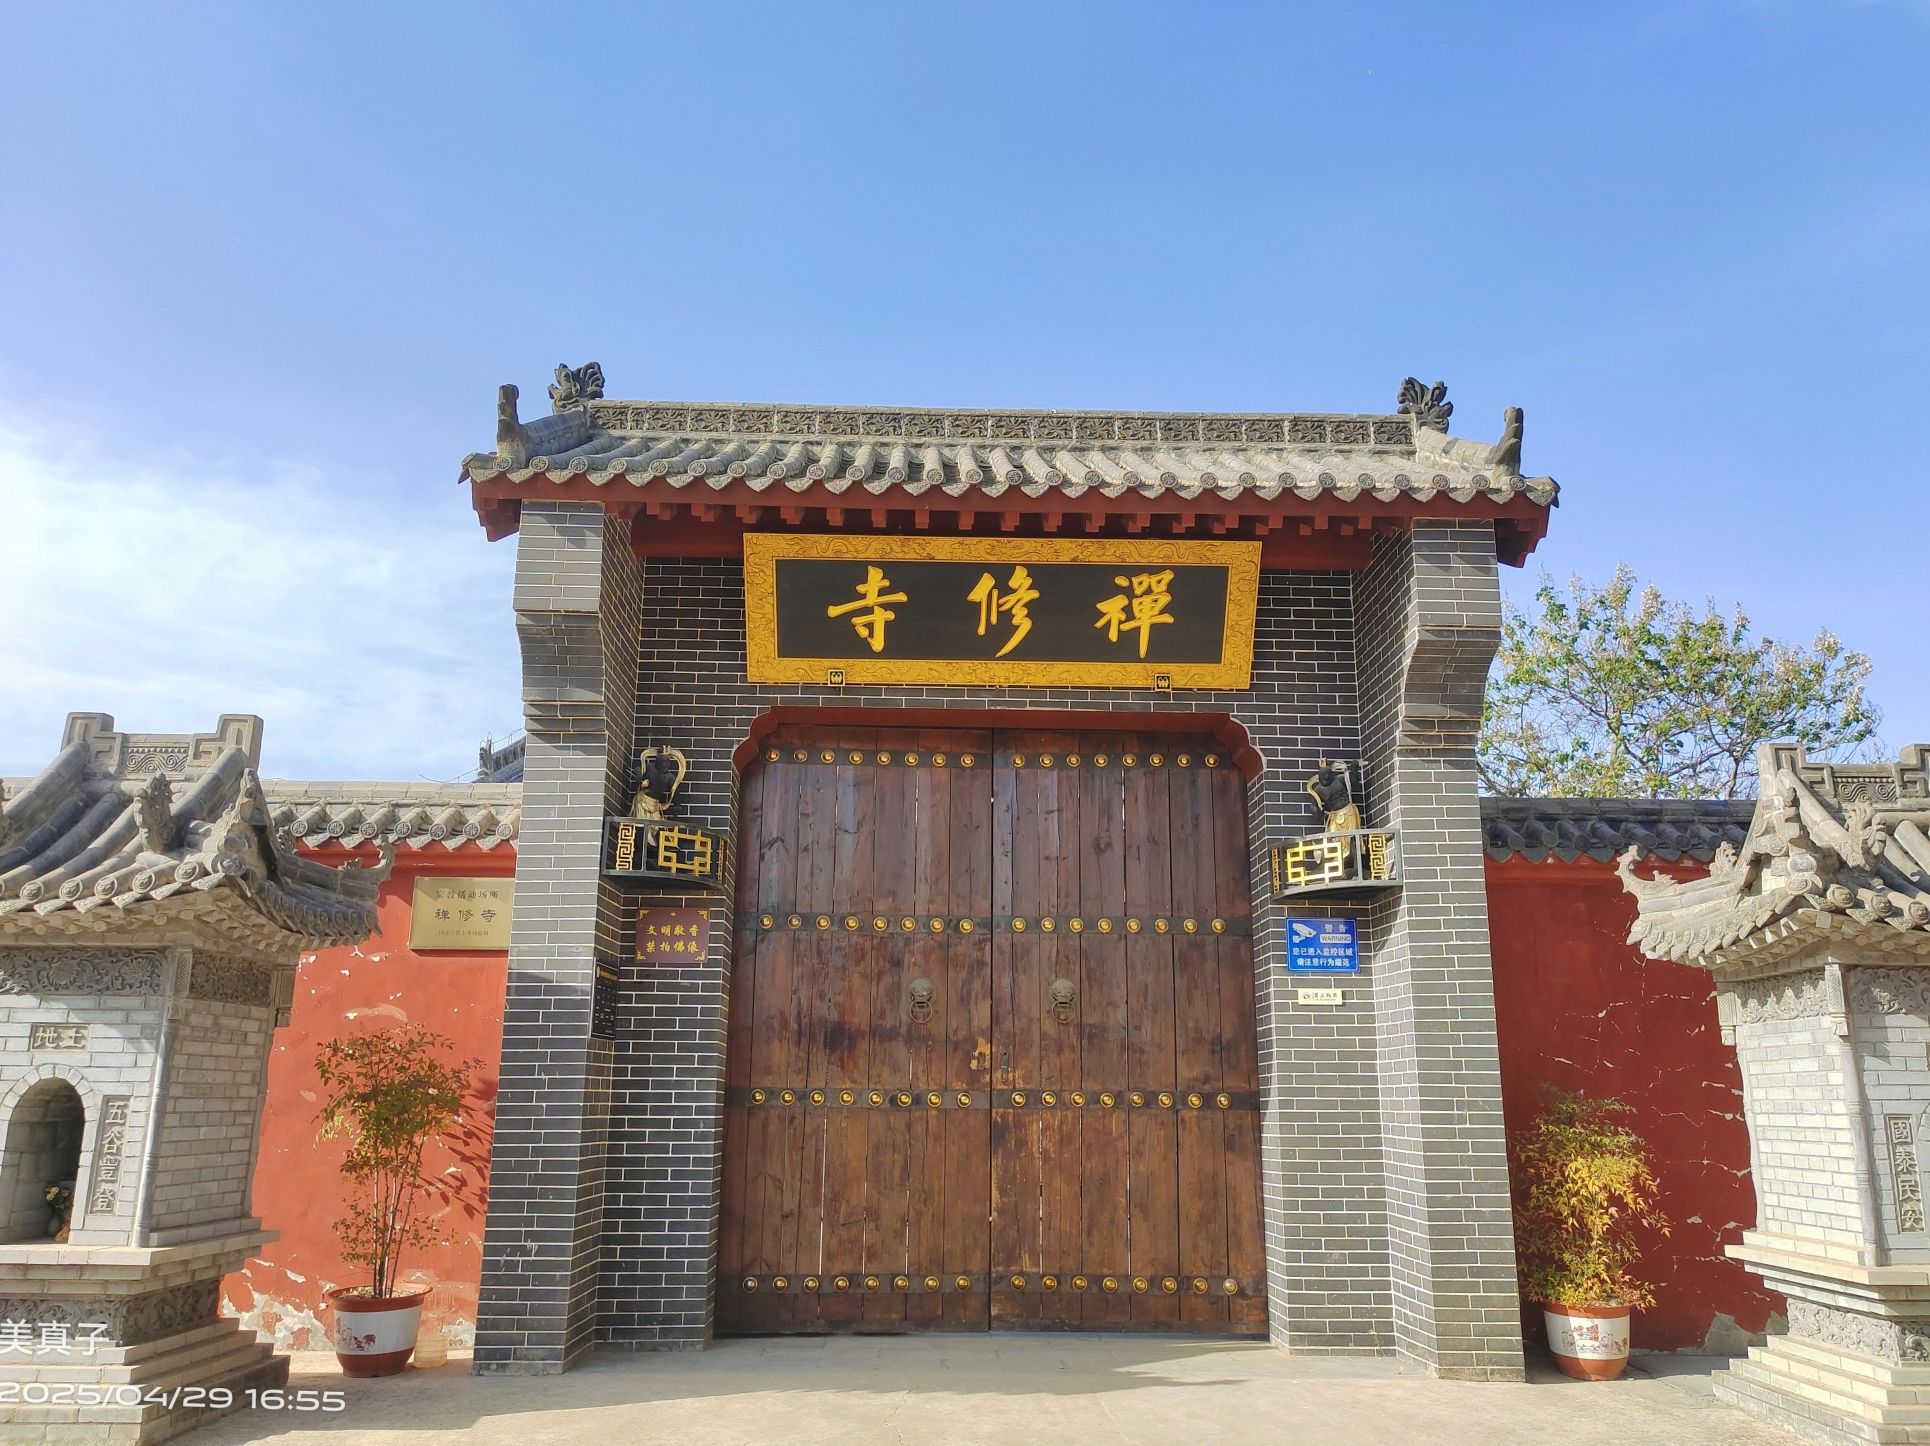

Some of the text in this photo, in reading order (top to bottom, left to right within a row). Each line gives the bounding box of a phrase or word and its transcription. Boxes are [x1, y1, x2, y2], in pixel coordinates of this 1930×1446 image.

[434, 908, 497, 923] 禅修寺
[1292, 947, 1353, 956] 您已进入监控区域
[1296, 958, 1350, 967] 请注意行为规范
